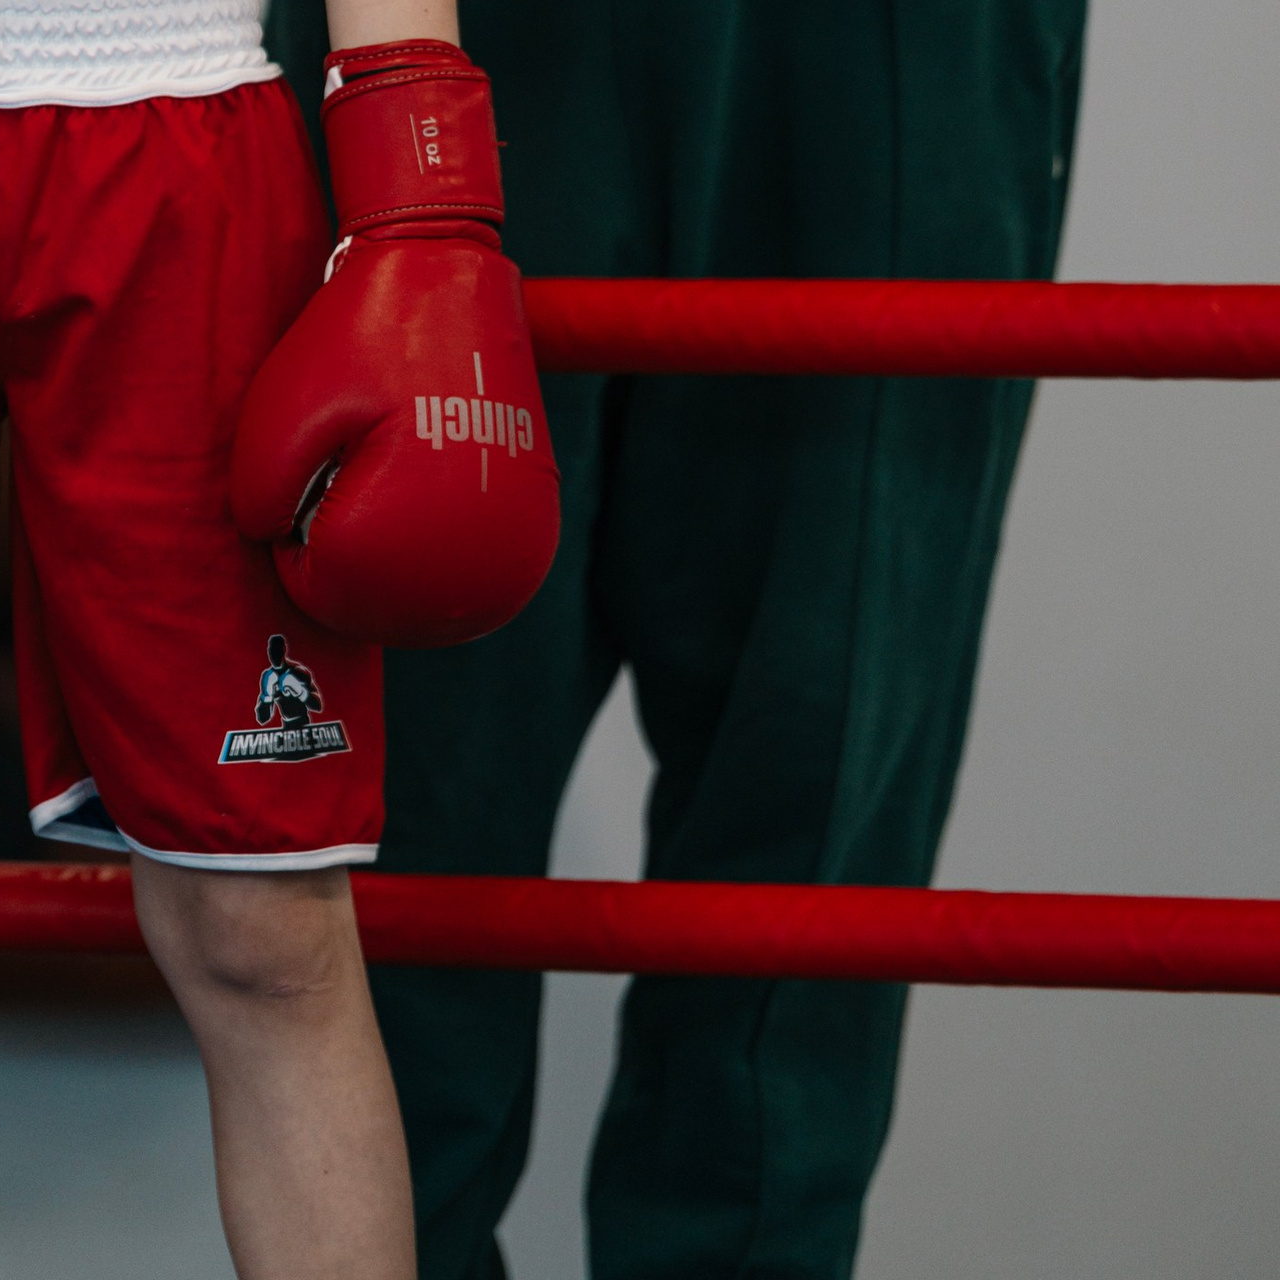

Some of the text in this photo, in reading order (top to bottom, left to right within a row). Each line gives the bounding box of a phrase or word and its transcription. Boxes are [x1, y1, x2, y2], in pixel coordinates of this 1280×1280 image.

[420, 116, 439, 138] 10
[414, 396, 534, 458] clinch
[229, 725, 344, 757] INVINCIBLE SOUL
